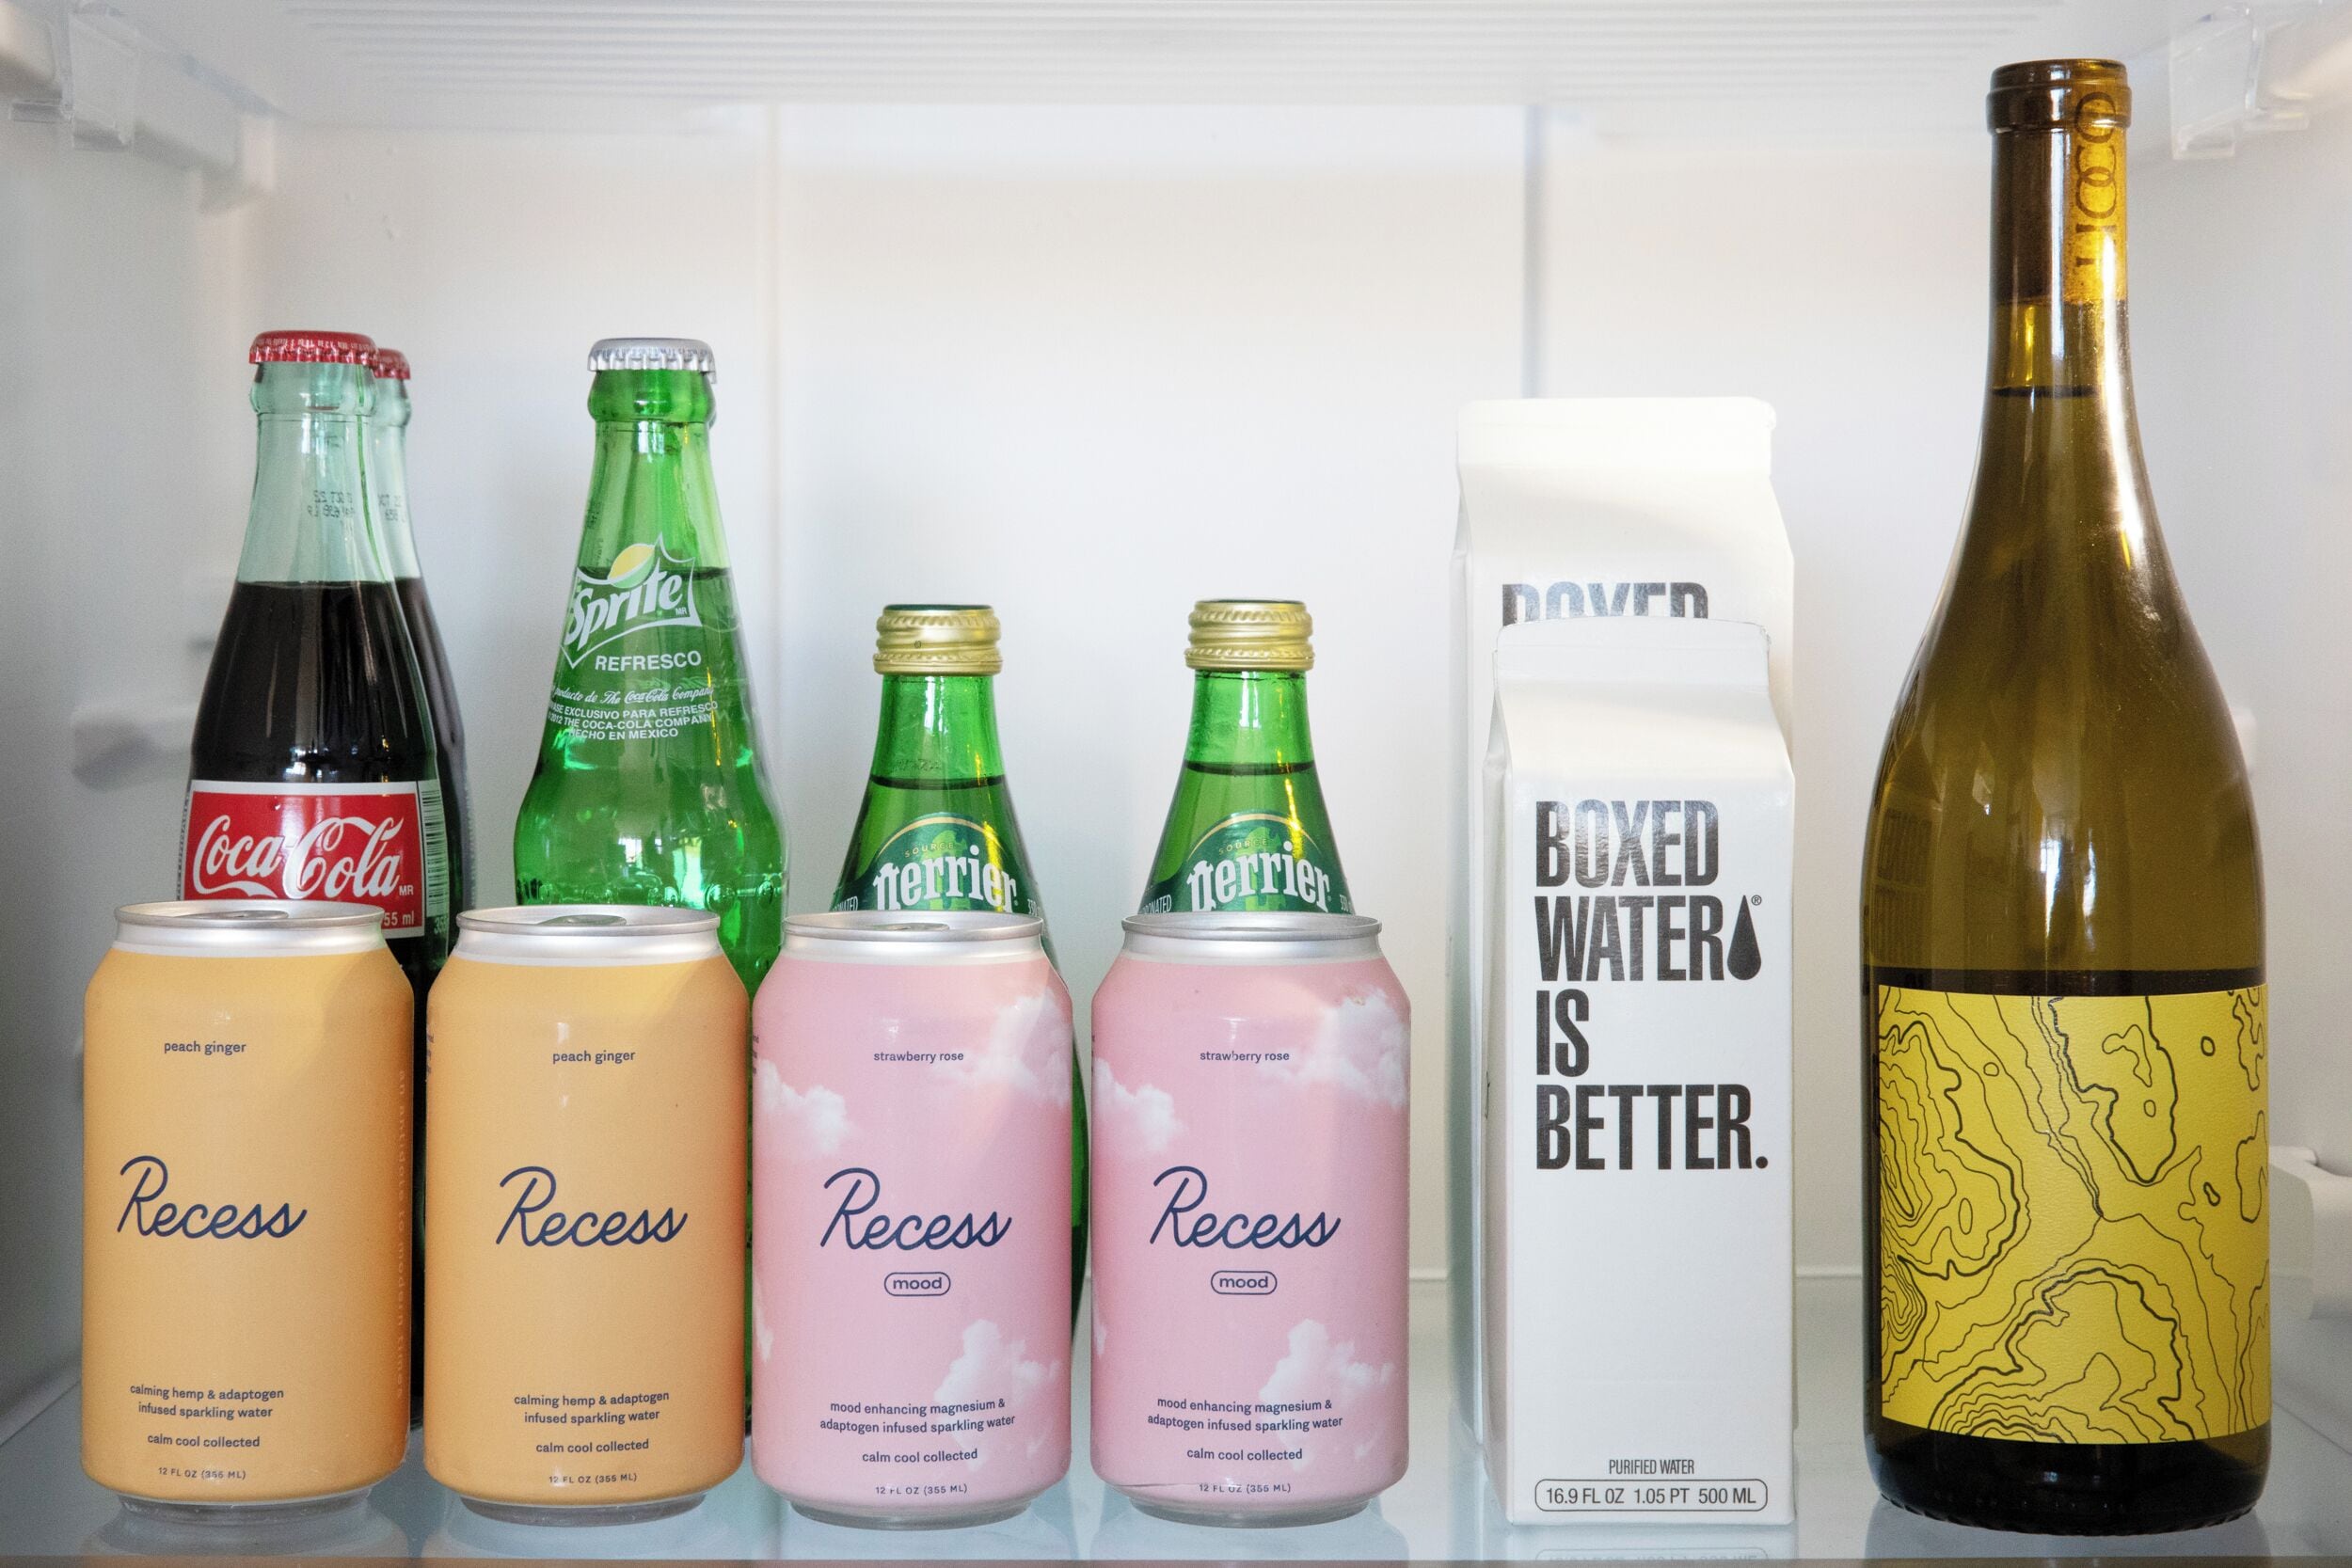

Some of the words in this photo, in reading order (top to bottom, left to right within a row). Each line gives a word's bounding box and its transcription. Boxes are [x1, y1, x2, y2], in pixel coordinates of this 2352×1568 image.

[564, 557, 683, 651] Sprite
[595, 651, 702, 672] REFRESCO
[584, 690, 598, 703] de
[600, 690, 621, 704] The
[564, 705, 619, 720] EXCLUSIVO
[623, 708, 657, 719] PARA
[660, 701, 718, 718] REFRESCO
[564, 718, 580, 728] THE
[581, 719, 652, 730] COCA-COLA
[655, 713, 713, 728] COMPANY
[568, 729, 606, 740] HECHO
[609, 731, 626, 740] EN
[628, 728, 678, 739] MEXICO
[904, 842, 954, 858] SOURCE
[1218, 838, 1268, 855] SOURCE
[1535, 800, 1719, 888] BOXED
[399, 885, 414, 895] MR
[382, 911, 398, 927] 55
[403, 910, 415, 925] ml
[1534, 895, 1724, 982] WATER
[1536, 989, 1590, 1077] IS
[164, 1040, 200, 1053] peach
[204, 1041, 246, 1055] ginger
[552, 1050, 591, 1064] peach
[595, 1050, 636, 1064] ginger
[873, 1051, 936, 1064] strawberry
[939, 1052, 964, 1061] rose
[1200, 1050, 1262, 1064] strawberry
[1264, 1051, 1290, 1061] rose
[1536, 1084, 1769, 1170] BETTER.
[118, 1155, 308, 1239] Recess
[496, 1165, 688, 1246] Recess
[819, 1167, 1012, 1250] Recess
[1150, 1165, 1341, 1249] Recess
[893, 1276, 942, 1290] mood
[1219, 1275, 1268, 1289] mood
[130, 1384, 169, 1400] calming
[172, 1387, 204, 1402] hemp
[207, 1389, 215, 1400] &
[219, 1388, 284, 1402] adaptogen
[514, 1394, 559, 1408] calming
[563, 1395, 596, 1408] hemp
[599, 1396, 607, 1405] &
[610, 1391, 669, 1405] adaptogen
[138, 1402, 176, 1417] infused
[180, 1406, 234, 1420] sparkling
[238, 1407, 273, 1418] water
[831, 1402, 861, 1414] mood
[865, 1403, 927, 1418] enhancing
[930, 1400, 995, 1416] magnesium
[998, 1398, 1005, 1408] &
[1157, 1398, 1186, 1409] mood
[1190, 1400, 1251, 1415] enhancing
[1255, 1400, 1322, 1416] magnesium
[1325, 1399, 1332, 1409] &
[525, 1412, 566, 1423] infused
[571, 1412, 625, 1426] sparkling
[628, 1410, 660, 1422] water
[820, 1418, 880, 1434] adaptogen
[883, 1421, 927, 1433] infused
[930, 1418, 984, 1434] sparkling
[987, 1415, 1015, 1428] water
[1148, 1414, 1204, 1431] adaptogen
[1208, 1418, 1251, 1431] infused
[1255, 1418, 1310, 1433] sparkling
[1312, 1417, 1343, 1429] water
[148, 1433, 172, 1446] calm
[176, 1435, 199, 1447] cool
[203, 1436, 261, 1448] collected
[536, 1442, 564, 1452] calm
[567, 1442, 593, 1453] cool
[596, 1438, 649, 1452] collected
[862, 1450, 890, 1463] calm
[894, 1451, 920, 1463] cool
[923, 1449, 977, 1462] collected
[1187, 1448, 1215, 1459] calm
[1217, 1449, 1244, 1461] cool
[1247, 1448, 1303, 1460] collected
[158, 1467, 167, 1476] 12
[171, 1468, 181, 1477] FL
[184, 1469, 197, 1478] OZ
[228, 1470, 246, 1481] ML)
[1609, 1459, 1657, 1474] PURIFIED
[1660, 1459, 1694, 1474] WATER
[595, 1475, 617, 1485] (355
[621, 1473, 638, 1482] ML)
[876, 1486, 885, 1495] 12
[906, 1486, 919, 1495] OZ
[924, 1485, 946, 1496] (355
[950, 1483, 968, 1494] ML)
[1200, 1483, 1209, 1492] 12
[1214, 1484, 1224, 1493] FL
[1246, 1483, 1269, 1495] (355
[1273, 1482, 1291, 1494] ML)
[1547, 1487, 1578, 1504] 16.9
[1582, 1487, 1600, 1504] FL
[1605, 1487, 1625, 1504] OZ
[1634, 1487, 1665, 1504] 1.05
[1670, 1487, 1690, 1504] PT
[1698, 1487, 1728, 1504] 500
[1733, 1487, 1756, 1504] ML
